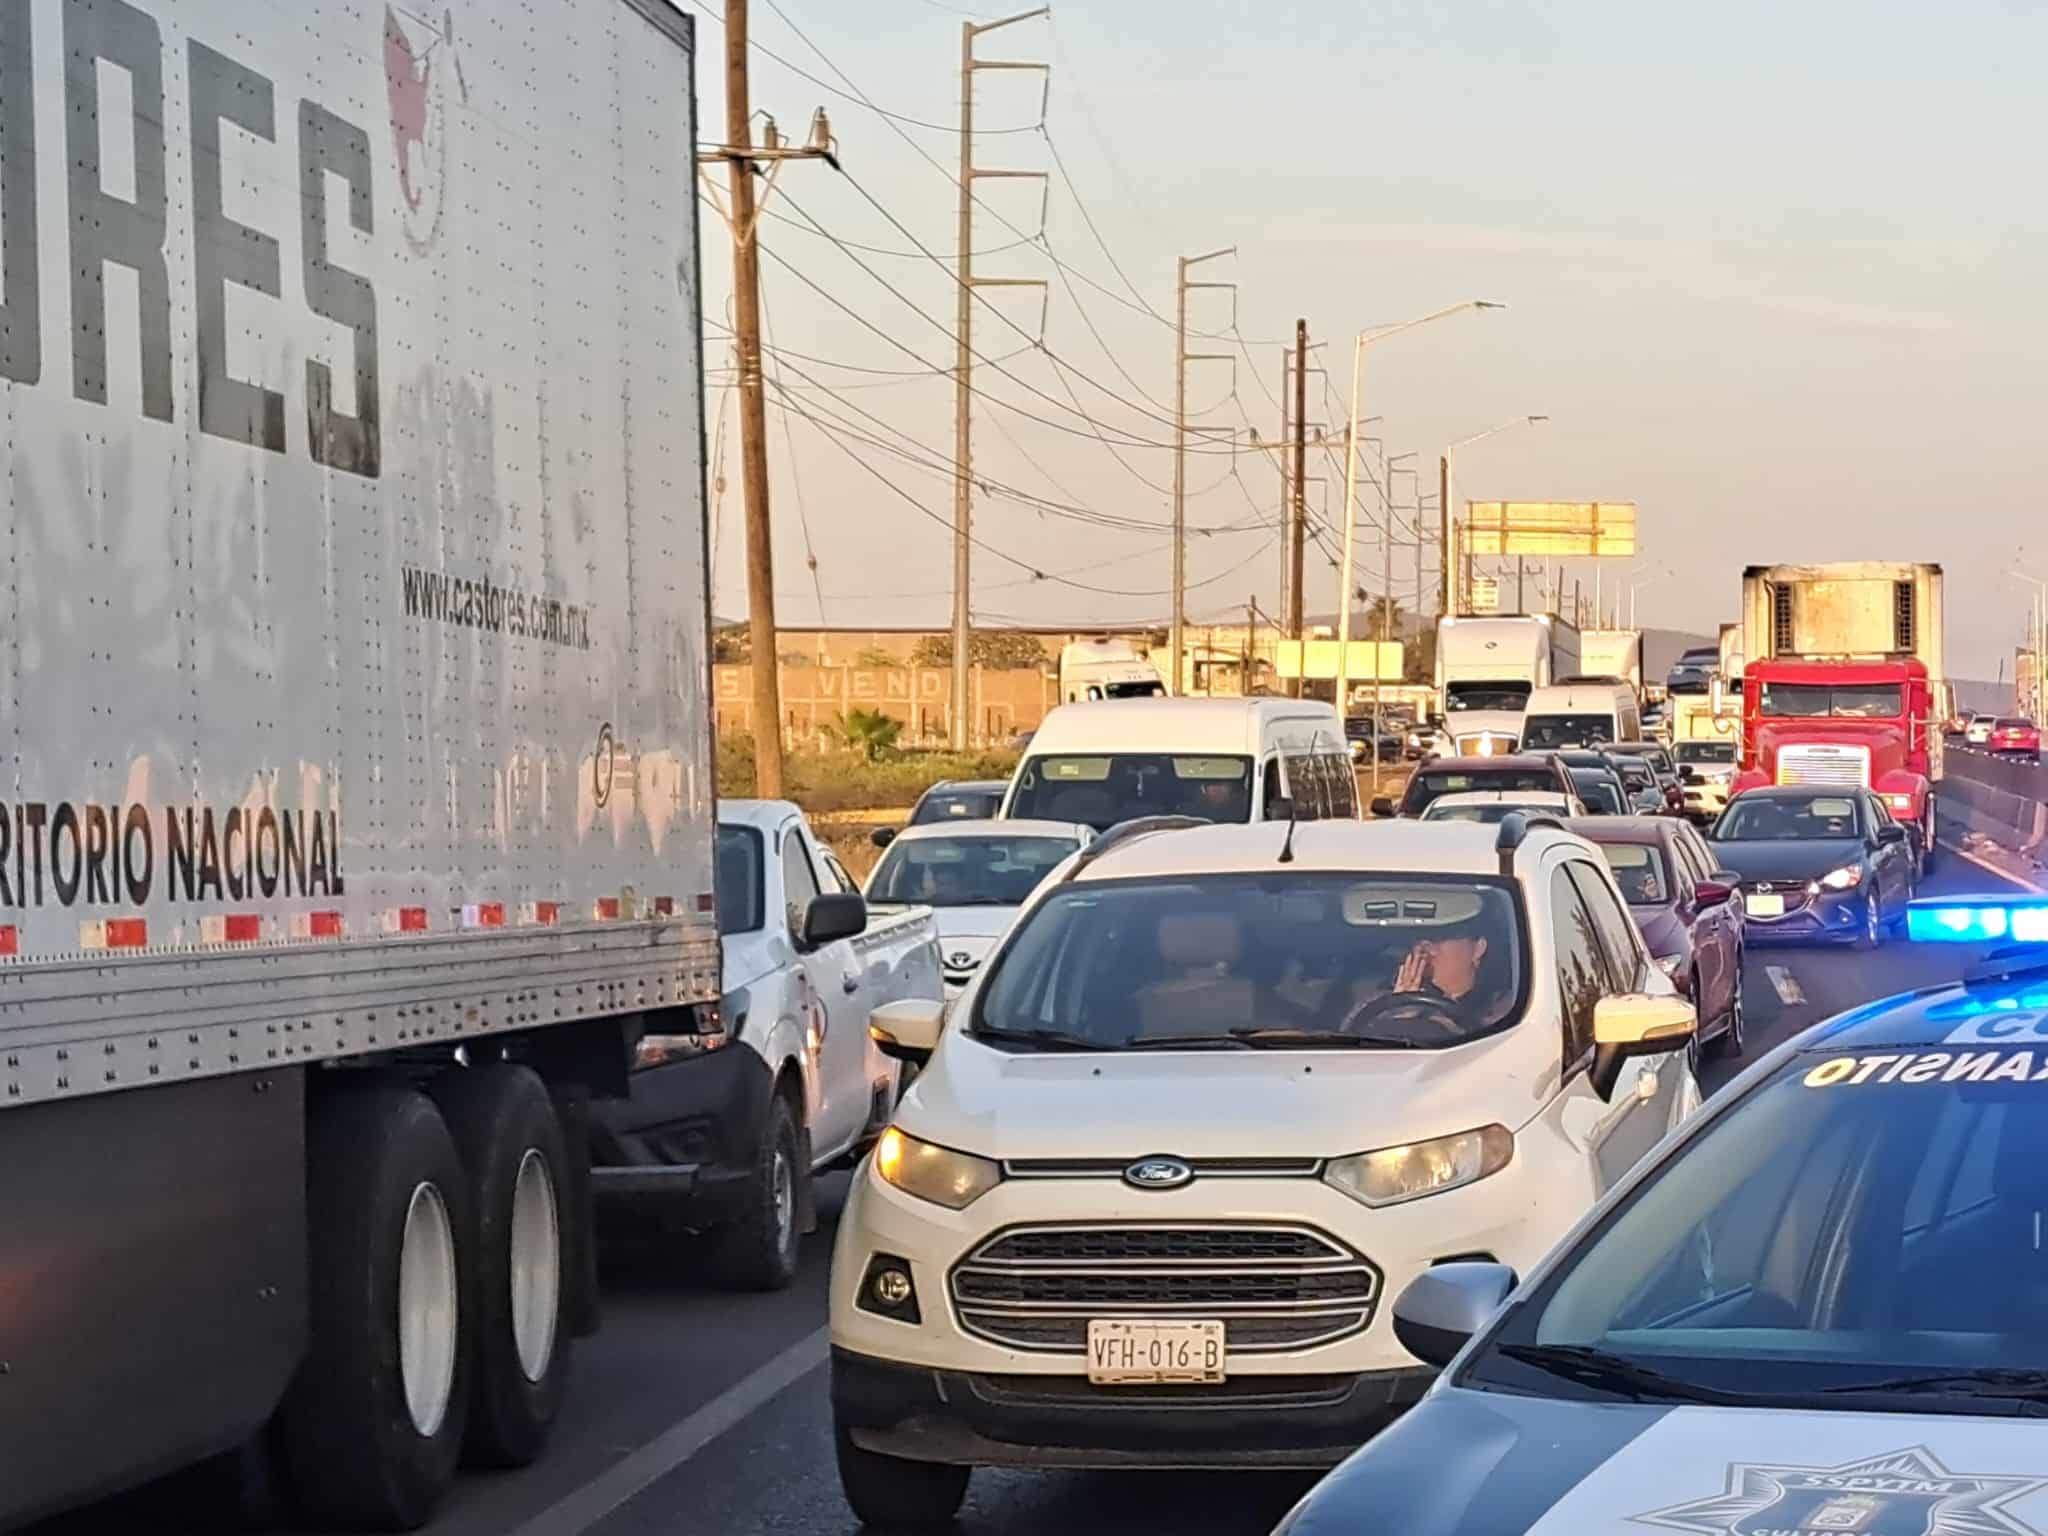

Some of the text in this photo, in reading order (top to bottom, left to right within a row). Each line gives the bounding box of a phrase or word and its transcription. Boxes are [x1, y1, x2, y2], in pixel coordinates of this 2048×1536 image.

[401, 567, 590, 650] www.castores.com.mx
[166, 802, 344, 902] NACIONAL
[1094, 1338, 1218, 1368] VFH-016-B
[1804, 1475, 1953, 1492] SSPYTM
